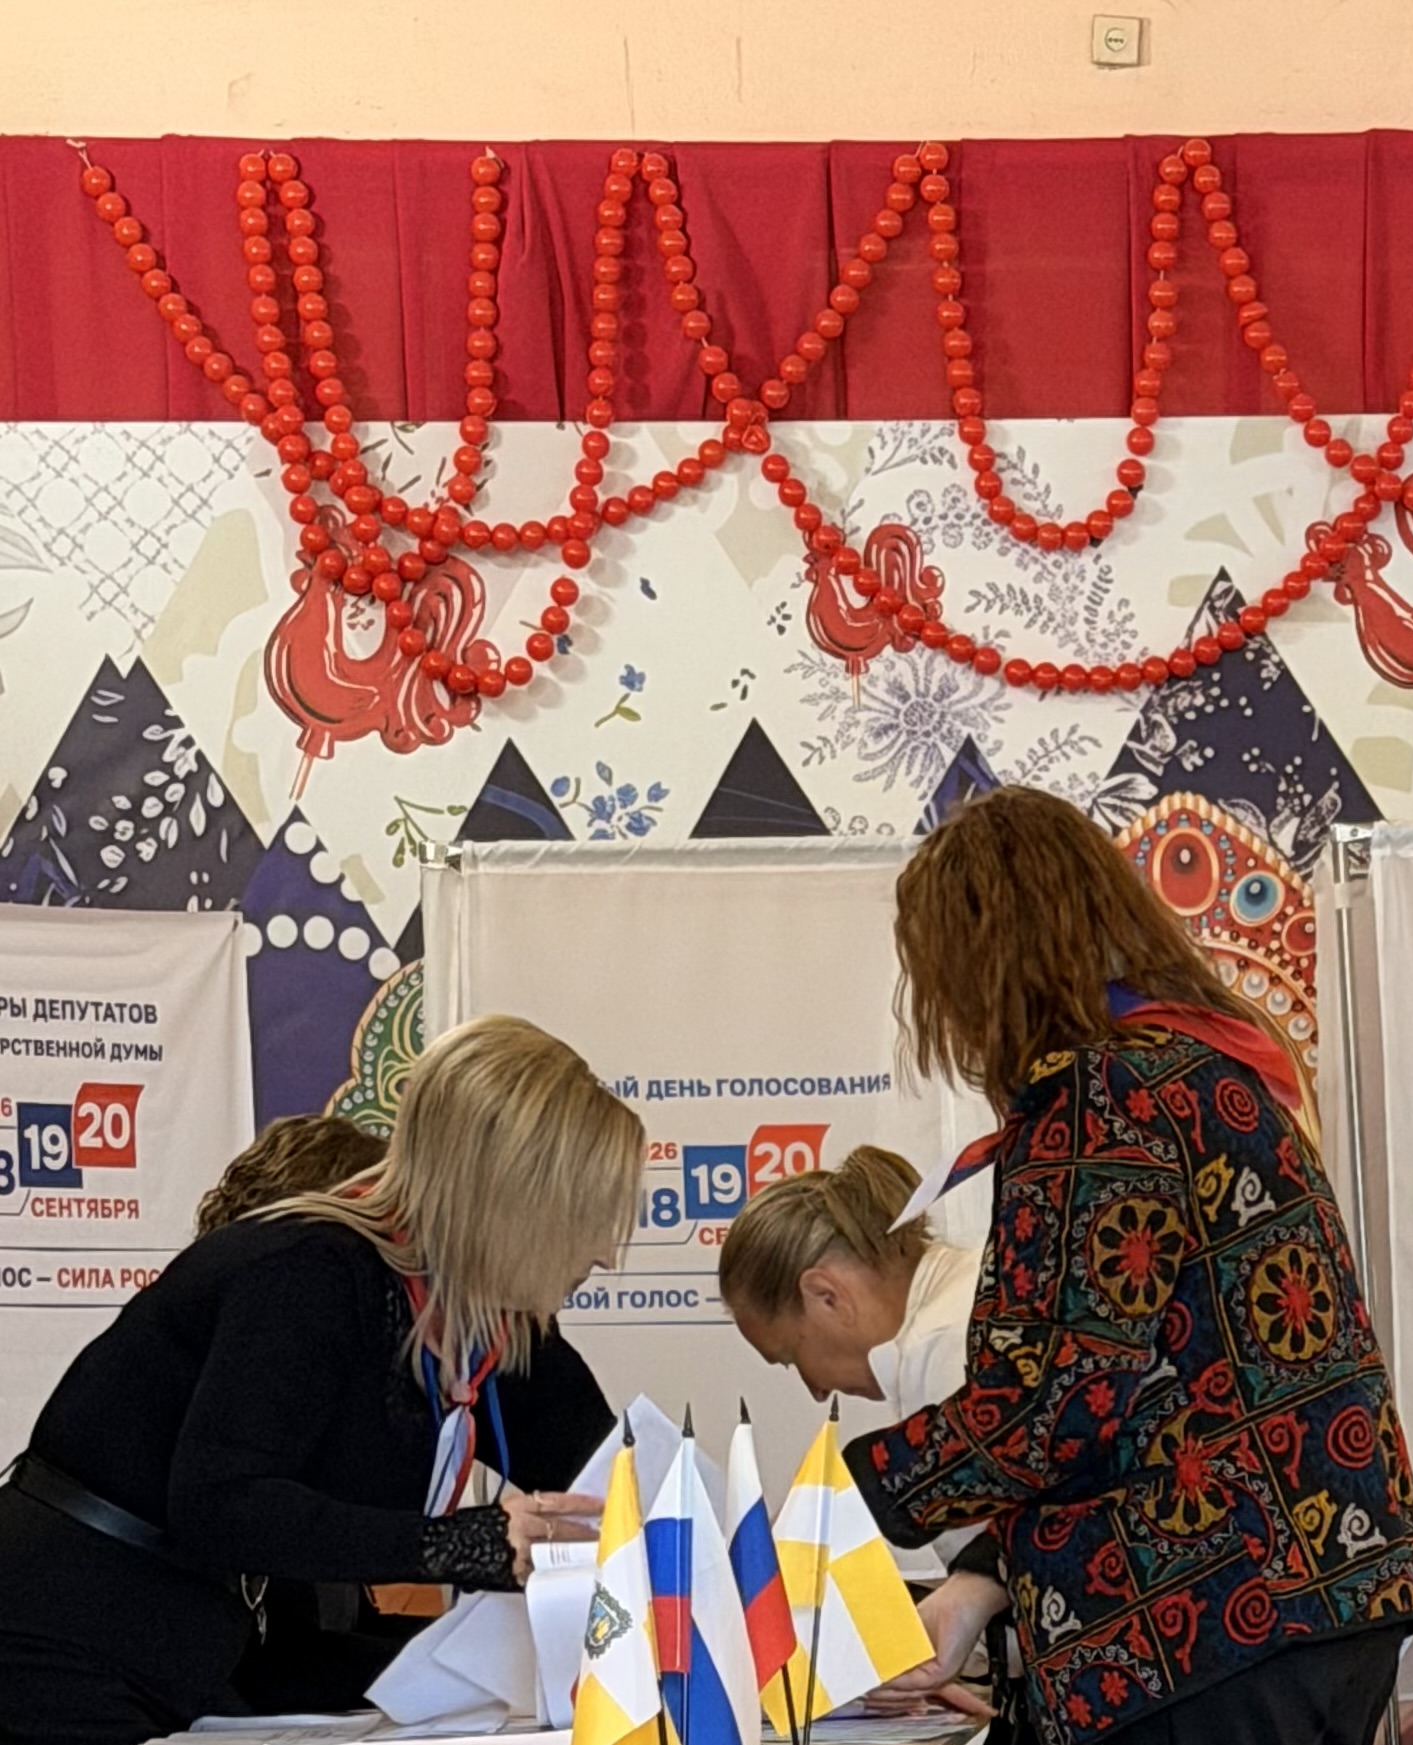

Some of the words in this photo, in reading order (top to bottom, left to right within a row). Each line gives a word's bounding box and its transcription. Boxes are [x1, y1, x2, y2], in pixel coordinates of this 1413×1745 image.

[33, 998, 158, 1024] ДЕПУТАТОВ
[0, 1037, 106, 1059] РСТВЕННОЙ
[110, 1044, 163, 1062] ДУМЫ
[646, 1079, 711, 1101] ДЕНЬ
[716, 1073, 891, 1097] ГОЛОСОВАНИЯ
[23, 1124, 69, 1171] 19
[78, 1102, 131, 1149] 20
[645, 1142, 678, 1161] 26
[691, 1163, 743, 1204] 19
[753, 1142, 814, 1183] 20
[30, 1196, 140, 1219] СЕНТЯБРЯ
[0, 1267, 31, 1288] ОС
[57, 1267, 114, 1288] СИЛА
[617, 1289, 699, 1309] ГОЛОС
